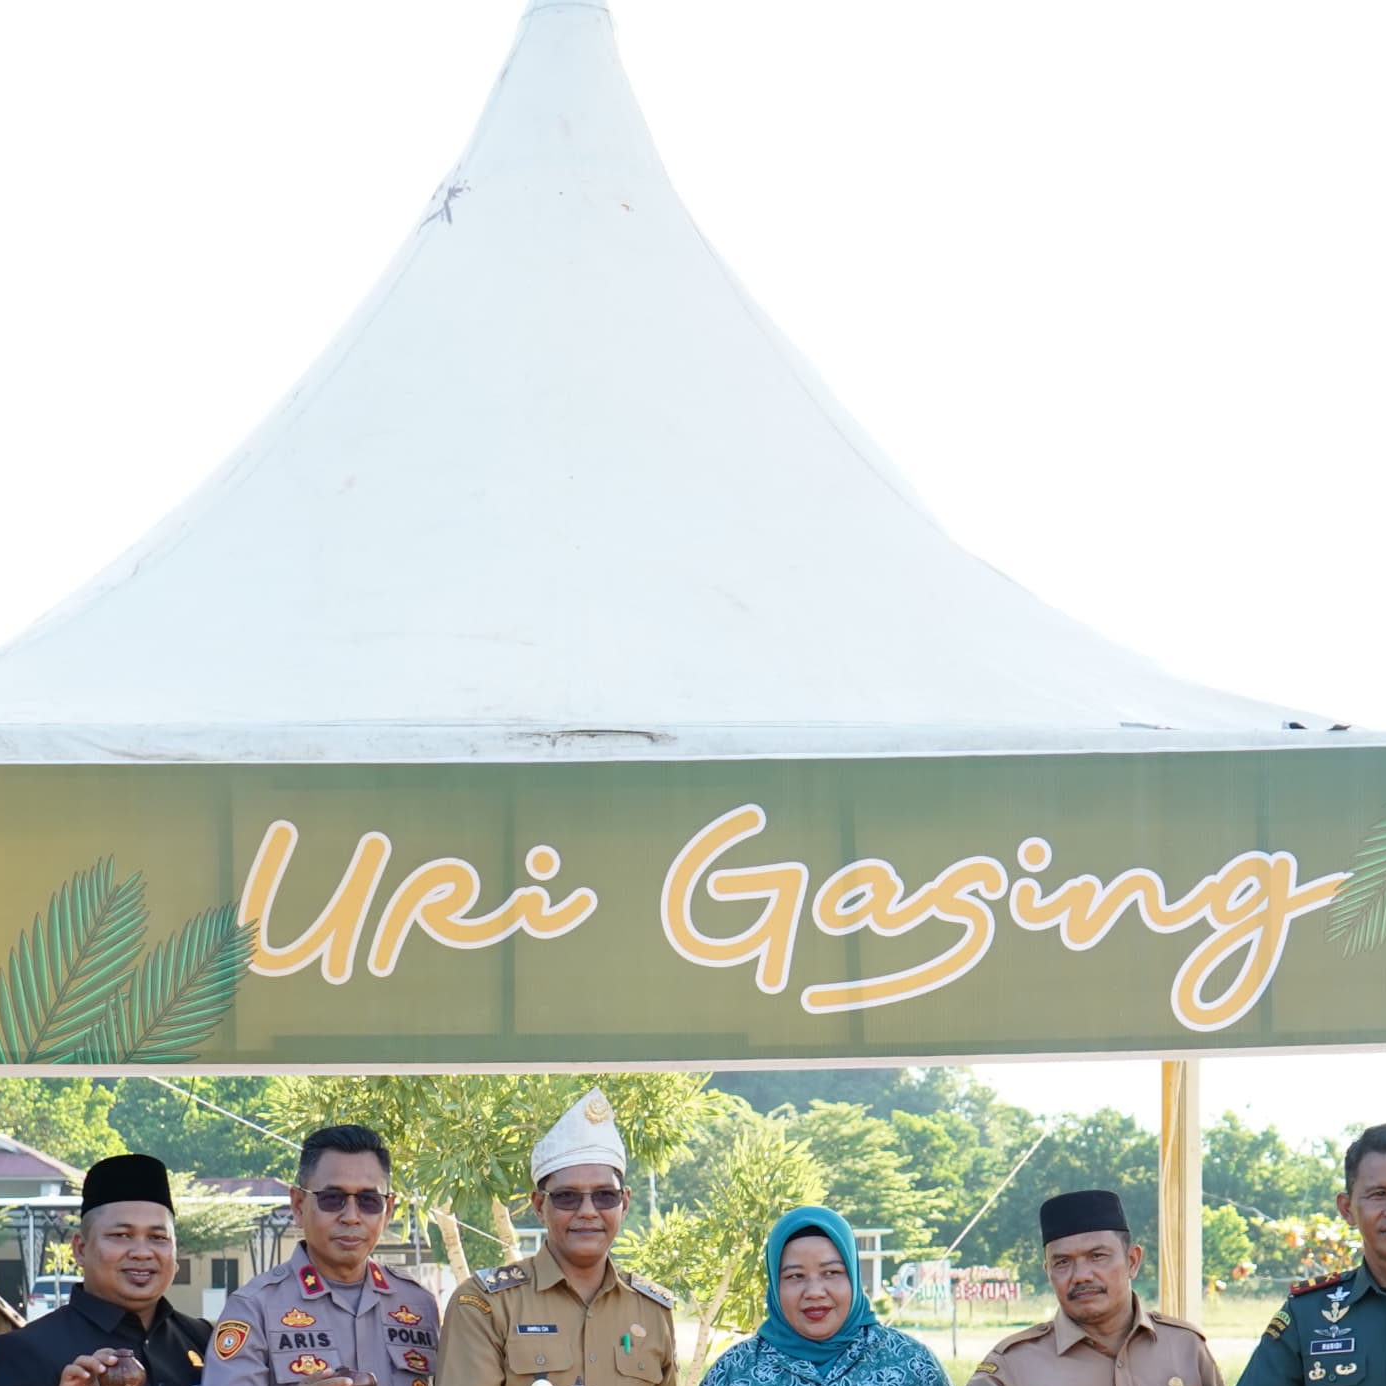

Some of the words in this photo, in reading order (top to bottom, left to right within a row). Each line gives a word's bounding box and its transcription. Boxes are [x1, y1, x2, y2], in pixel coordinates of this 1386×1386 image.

[660, 803, 1355, 1032] Gasing
[279, 1332, 331, 1349] ARIS
[388, 1327, 433, 1346] POLRI
